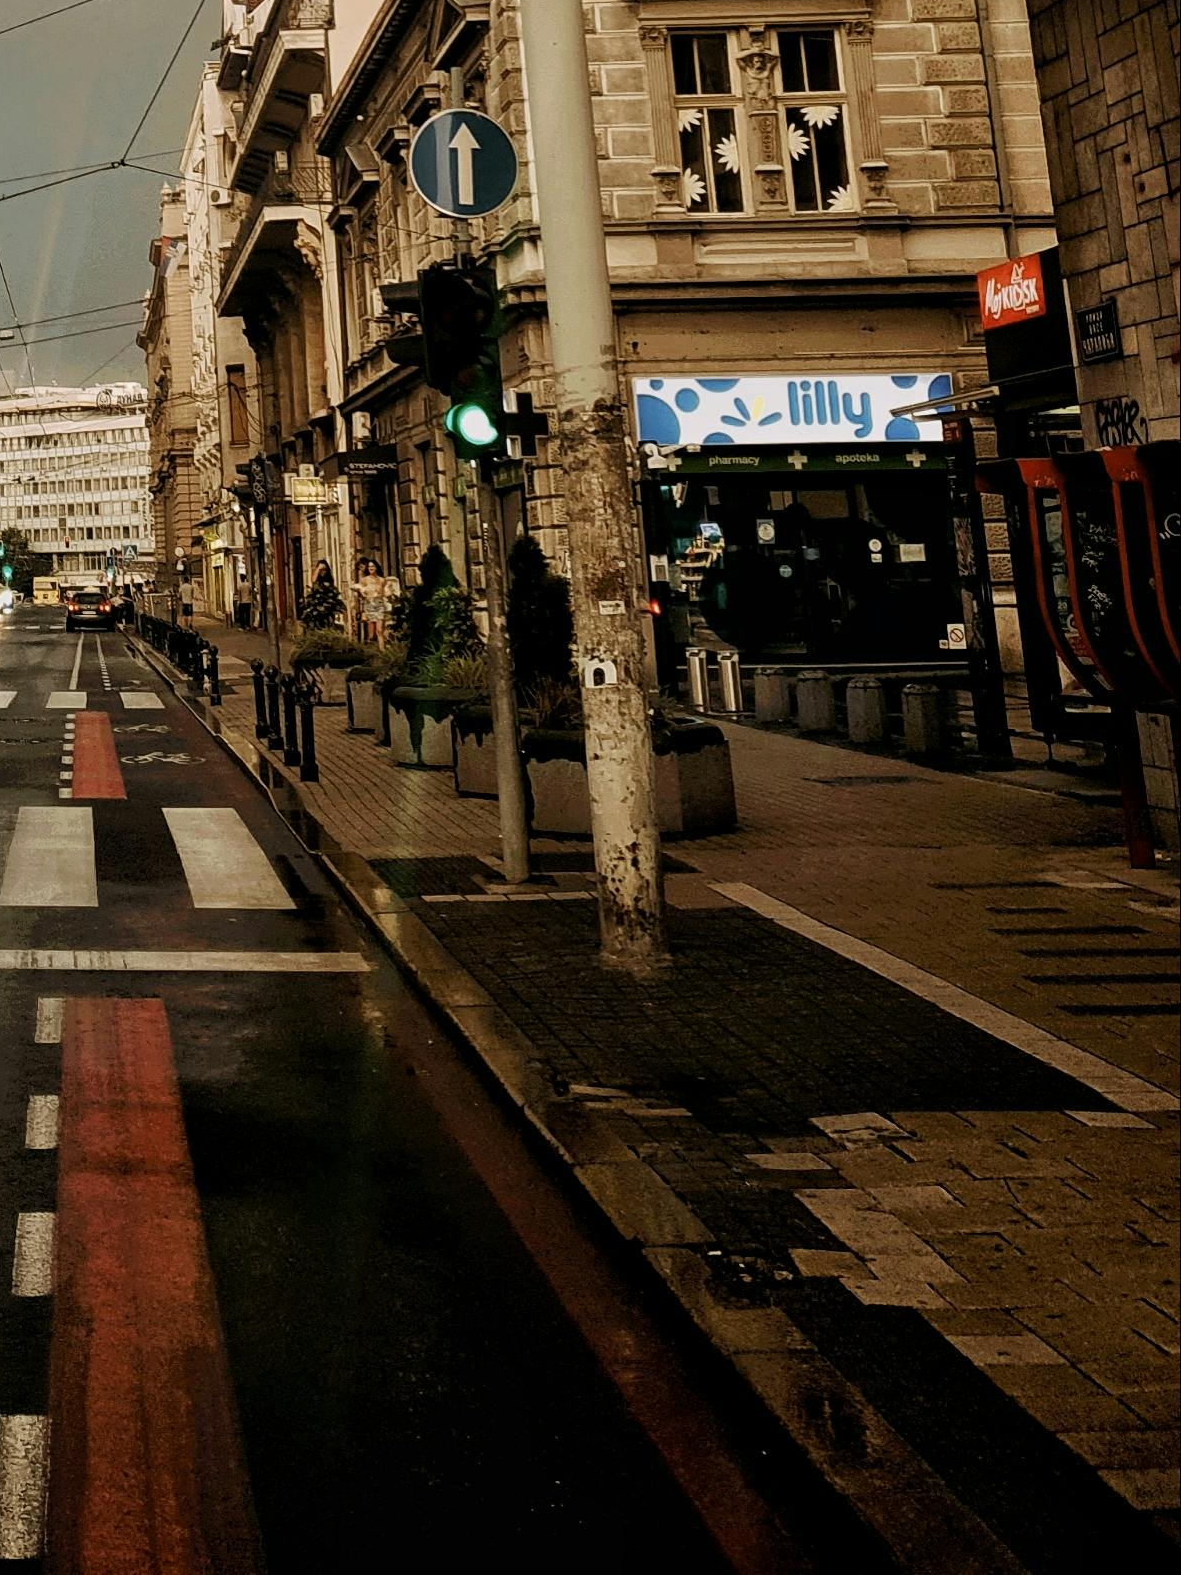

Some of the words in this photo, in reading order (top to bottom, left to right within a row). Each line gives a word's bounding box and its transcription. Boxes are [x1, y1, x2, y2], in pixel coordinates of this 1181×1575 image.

[787, 380, 873, 439] lilly
[708, 454, 760, 466] pharmacy
[835, 452, 880, 464] apoteka
